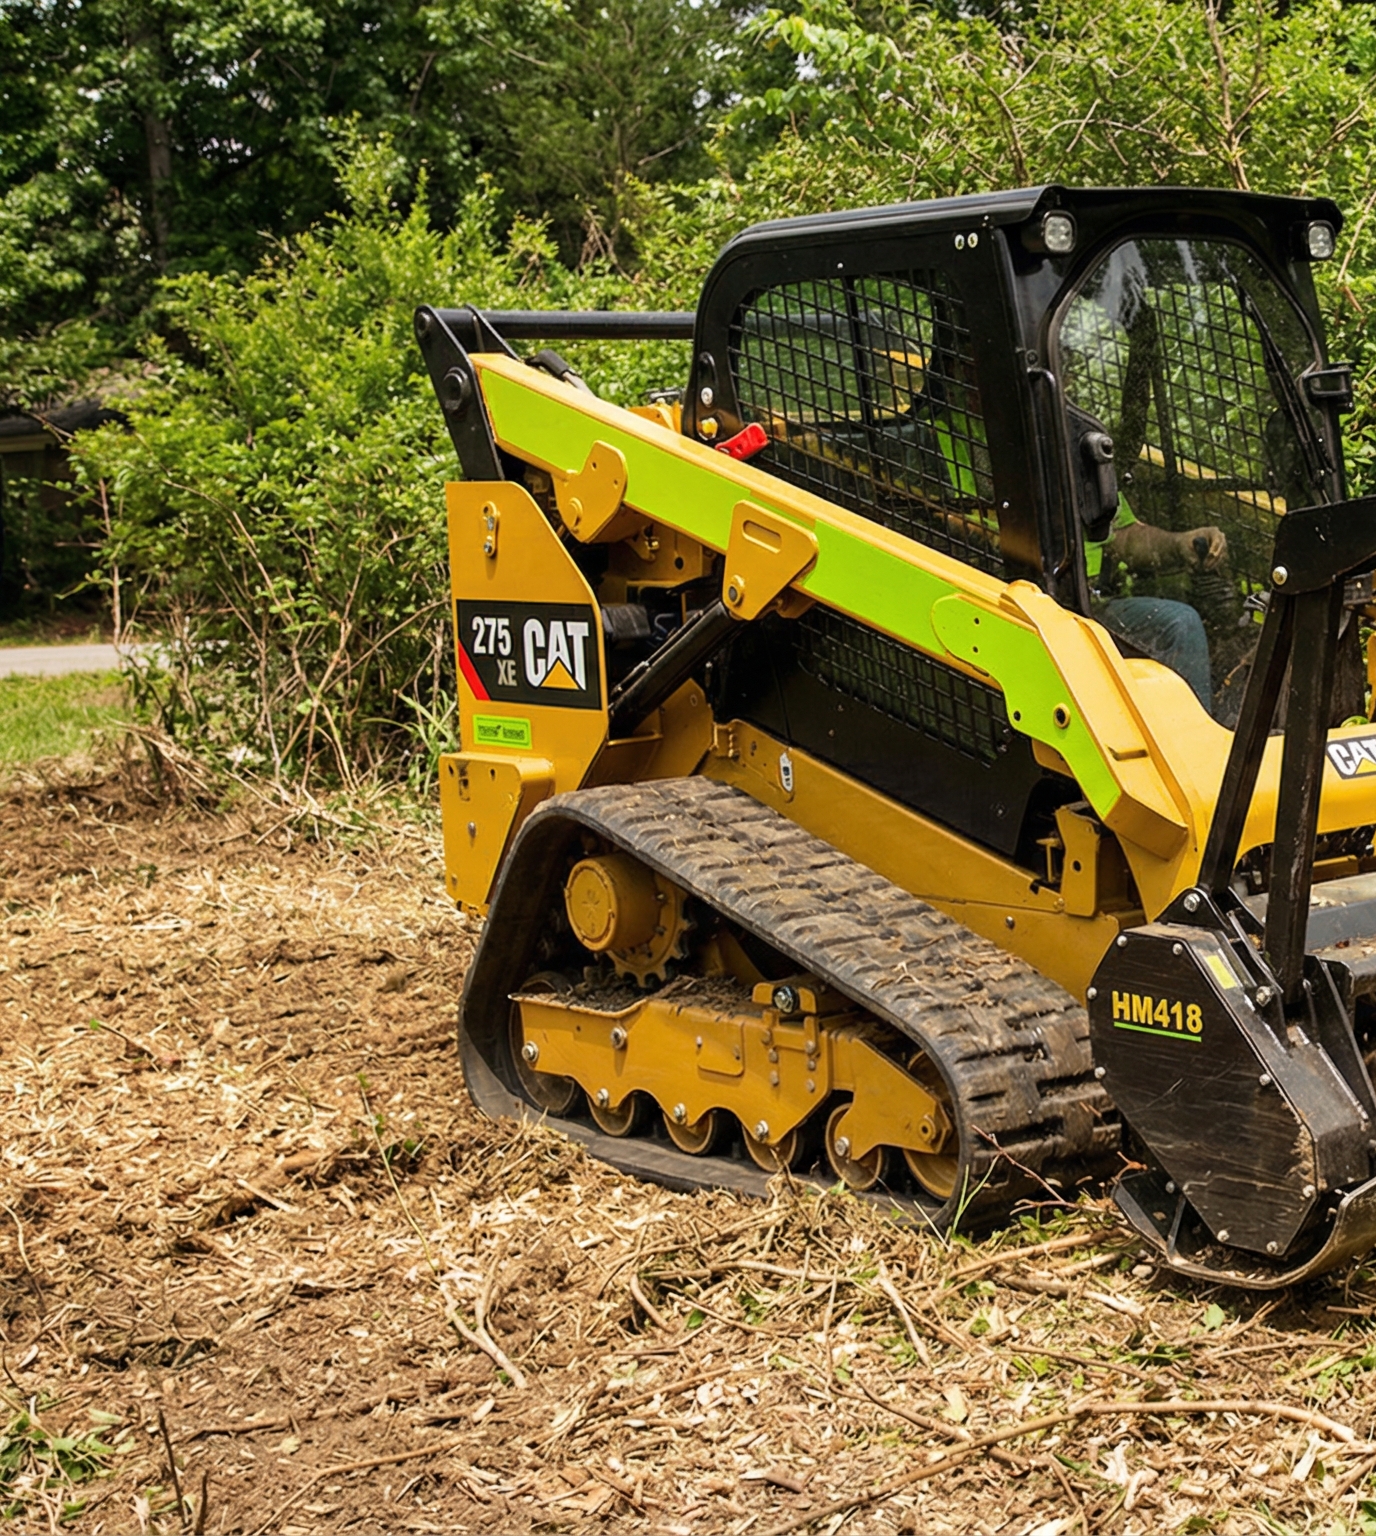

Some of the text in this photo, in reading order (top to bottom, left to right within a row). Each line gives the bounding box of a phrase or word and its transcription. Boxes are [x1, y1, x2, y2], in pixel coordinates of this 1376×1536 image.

[472, 616, 512, 656] 275
[523, 618, 589, 691] CAT
[497, 659, 517, 686] XE
[1112, 990, 1203, 1033] HM418
